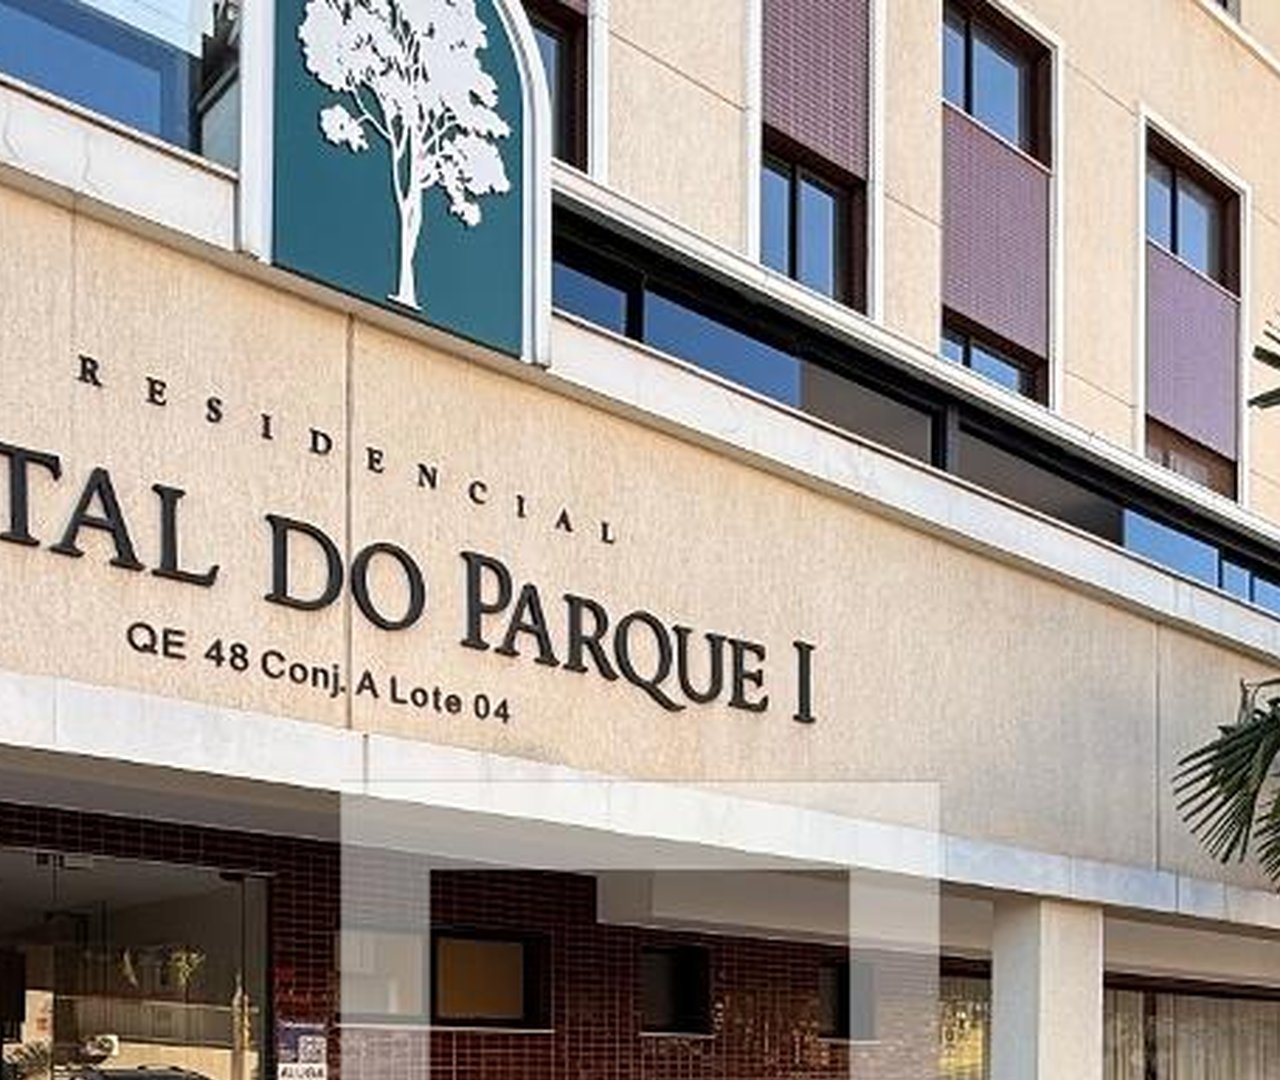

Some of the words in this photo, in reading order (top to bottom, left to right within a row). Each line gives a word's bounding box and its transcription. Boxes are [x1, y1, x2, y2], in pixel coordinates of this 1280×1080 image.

[78, 355, 615, 544] RESIDENCIAL
[127, 623, 186, 659] QE
[204, 639, 249, 671] 48
[262, 651, 346, 698] Conj.
[357, 671, 378, 698] A
[391, 677, 461, 713] Lote
[475, 695, 510, 723] 04
[265, 515, 425, 631] DO
[460, 552, 768, 712] PARQUE
[793, 642, 815, 724] I
